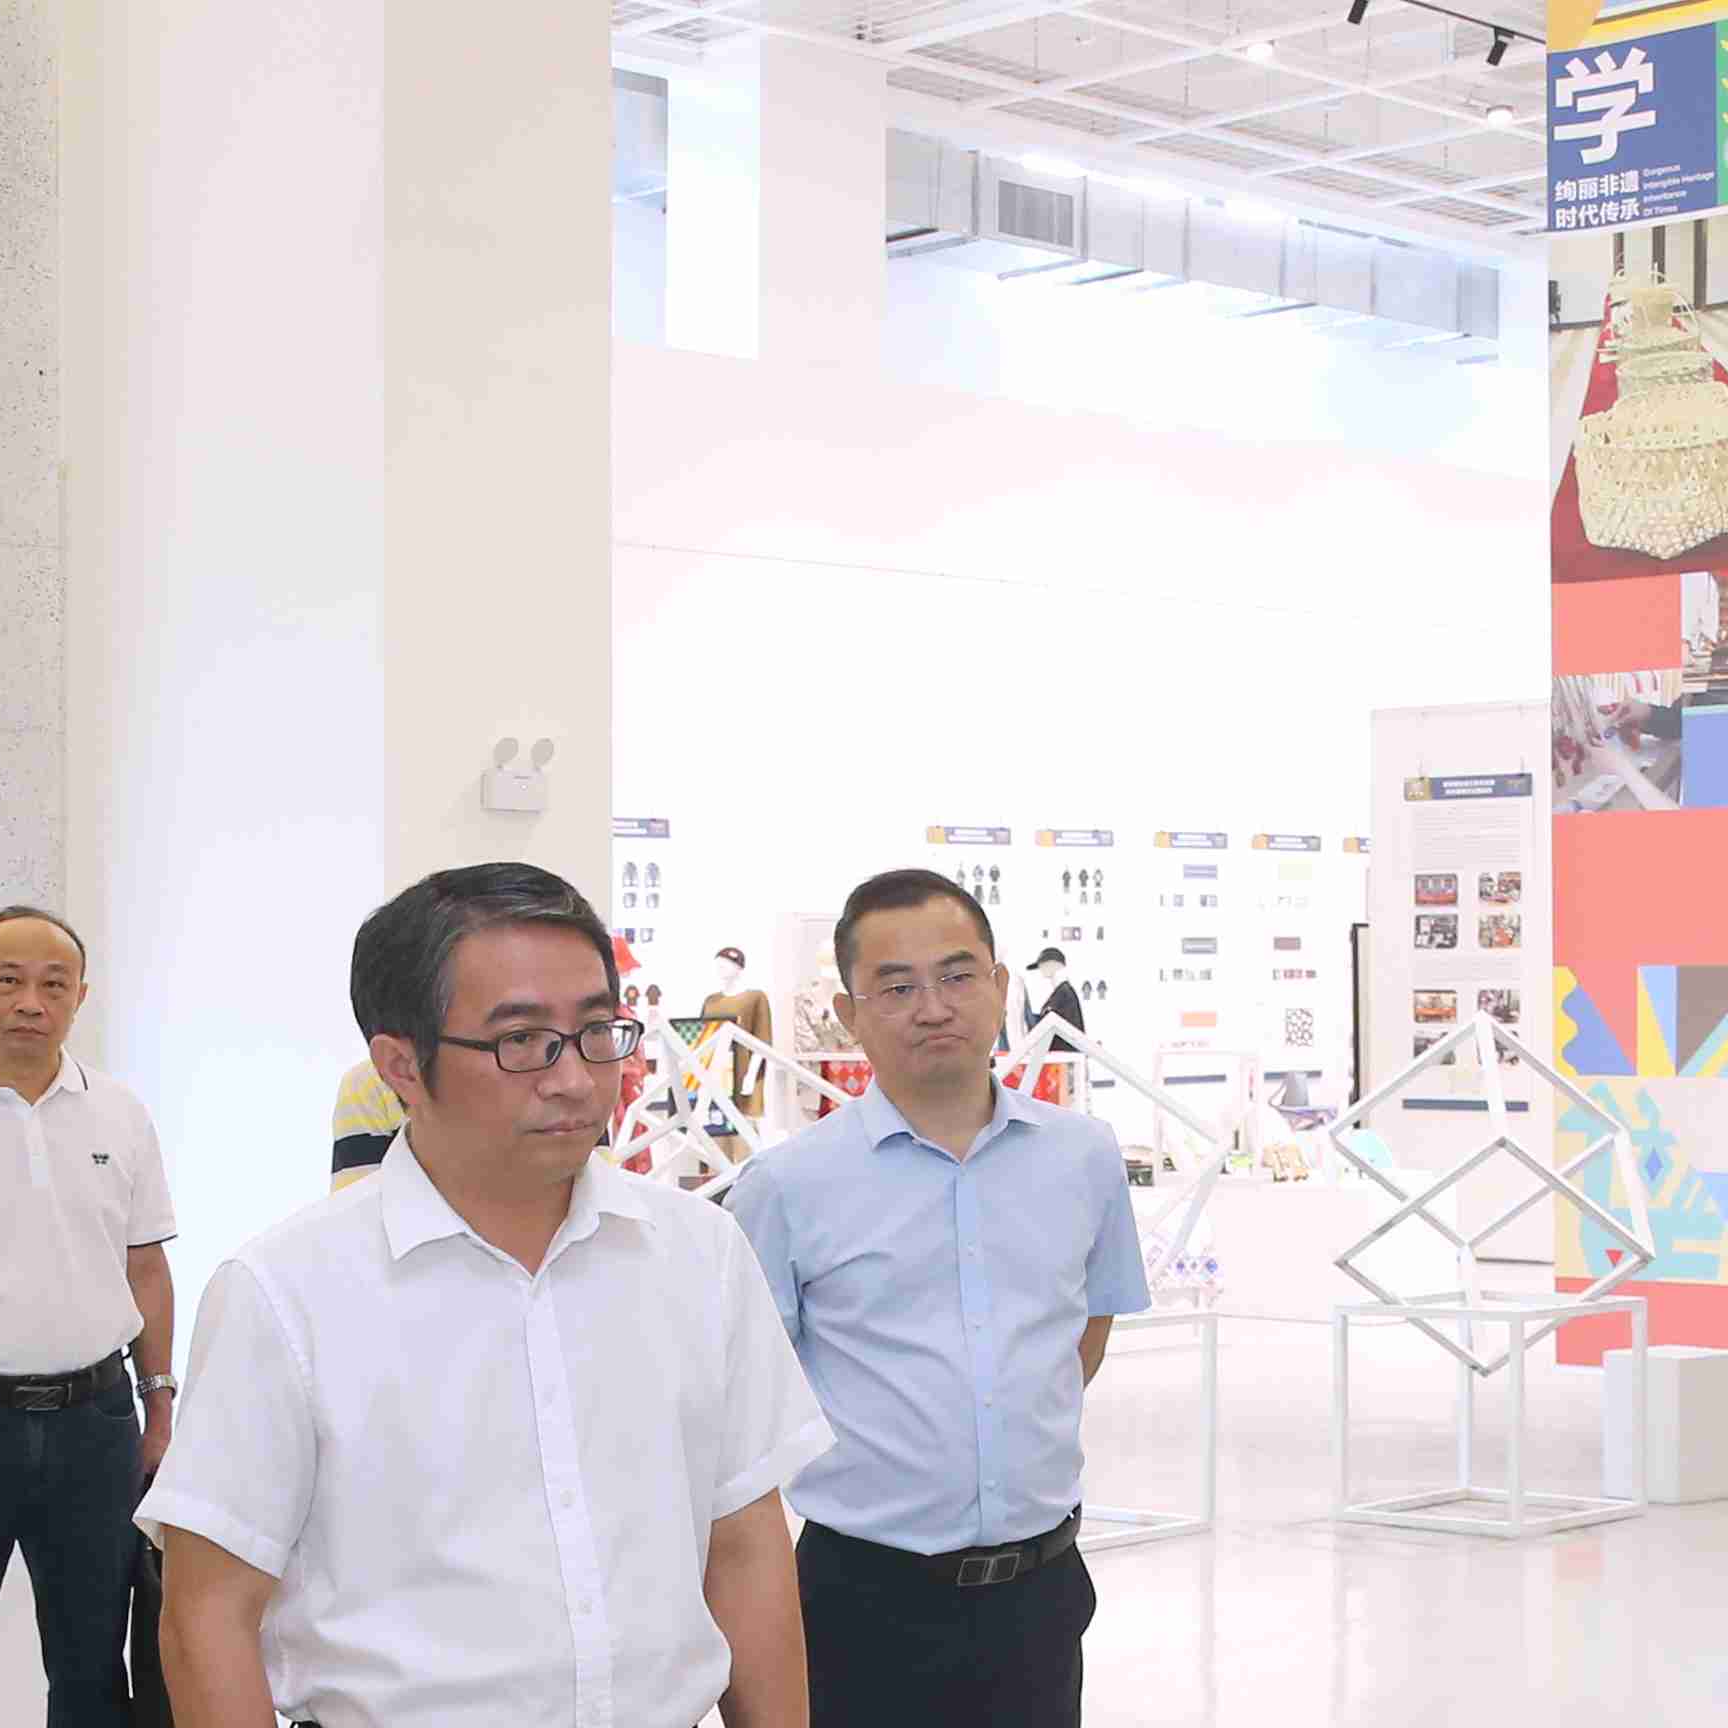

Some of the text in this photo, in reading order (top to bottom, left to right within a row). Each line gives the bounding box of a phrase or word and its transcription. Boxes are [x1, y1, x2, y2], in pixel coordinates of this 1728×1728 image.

[1553, 47, 1657, 165] 学
[1555, 170, 1640, 202] 绚丽非遗
[1555, 197, 1640, 229] 时代传承
